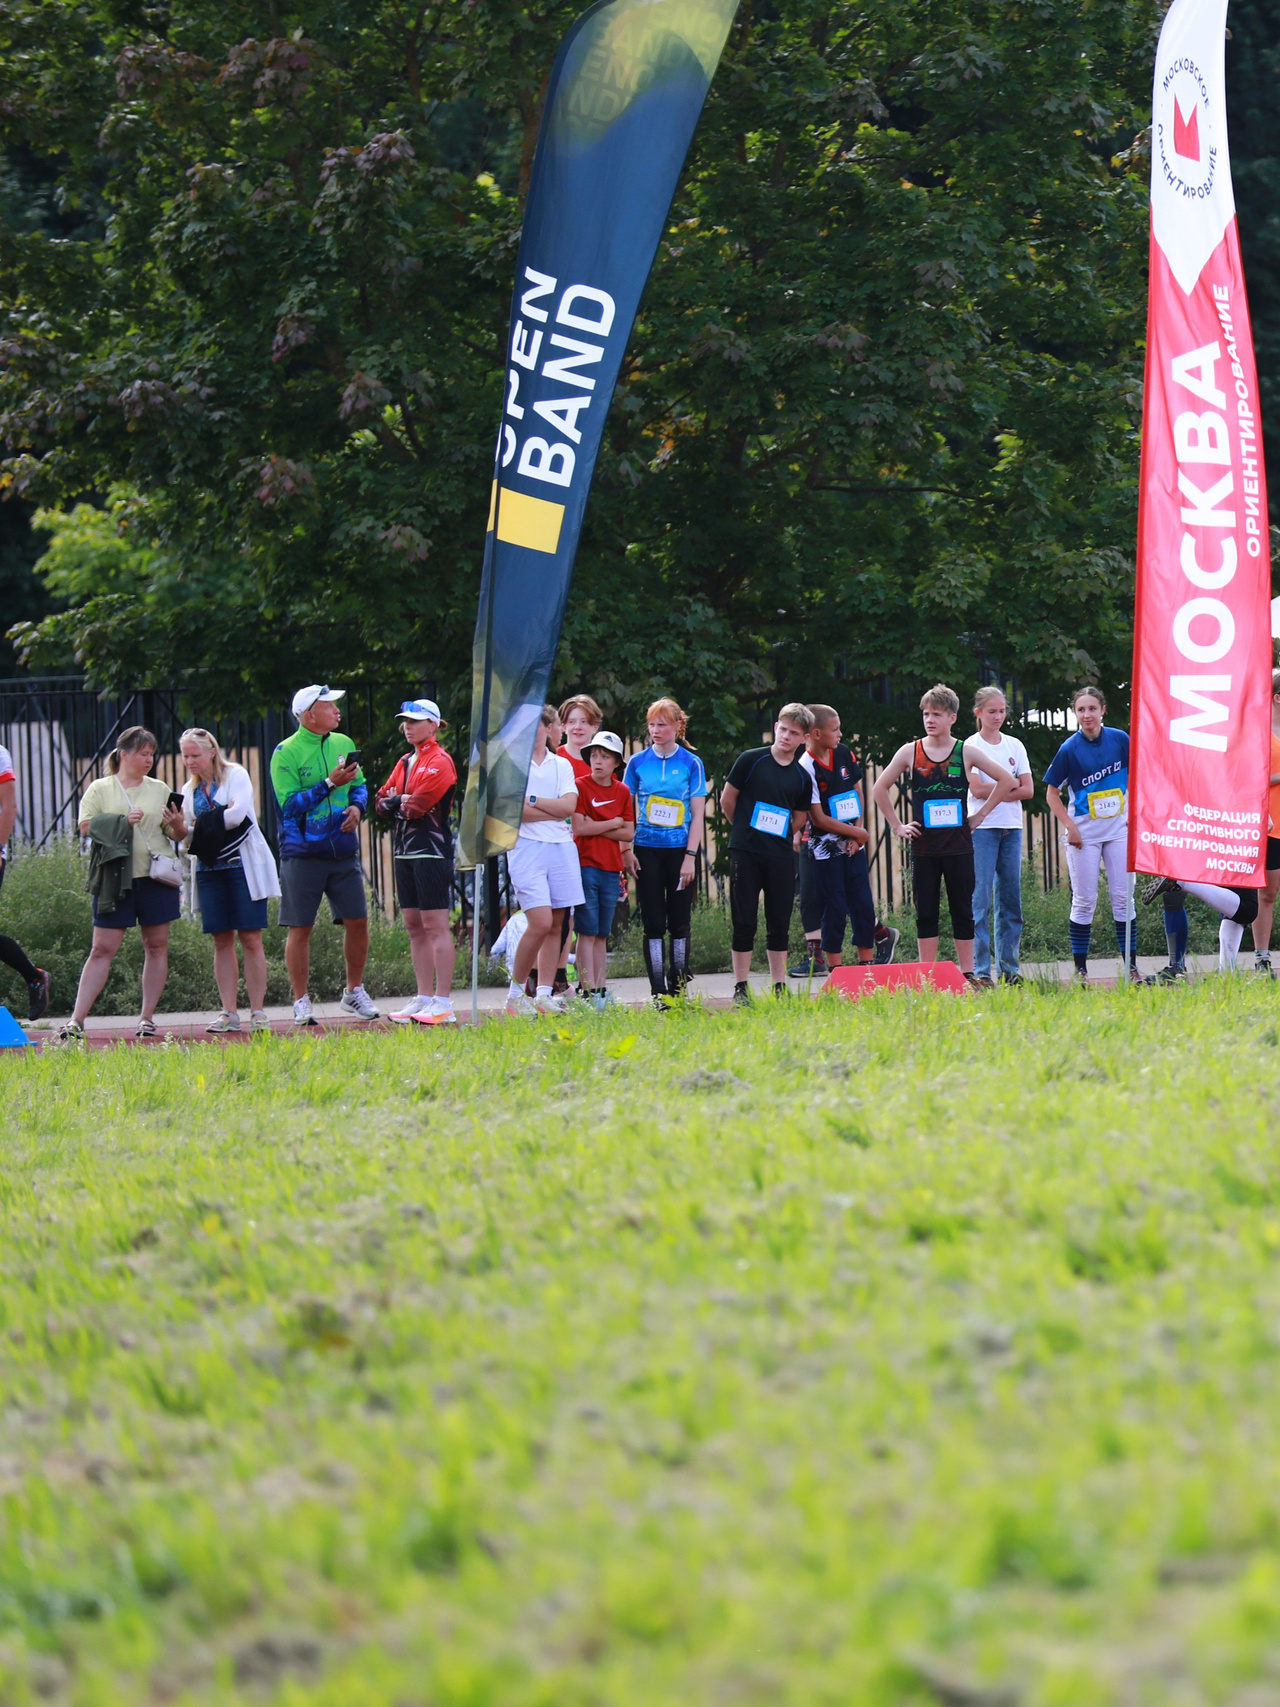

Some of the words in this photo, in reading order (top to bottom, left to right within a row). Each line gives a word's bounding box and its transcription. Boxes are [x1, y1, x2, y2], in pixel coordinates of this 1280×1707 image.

[1163, 57, 1210, 109] МОСКОВСКОЕ
[517, 284, 616, 488] BAND
[1213, 284, 1260, 558] ОРИЕНТИРОВАНИЕ
[1169, 341, 1238, 752] МОСКВА
[1082, 765, 1113, 787] СПОРТ
[1183, 803, 1261, 825] ФЕДЕРАЦИЯ
[1167, 819, 1261, 841] СПОРТИВНОГО
[1140, 831, 1260, 858] ОРИЕНТИРОВАНИЯ
[1206, 857, 1256, 874] МОСКВЫ
